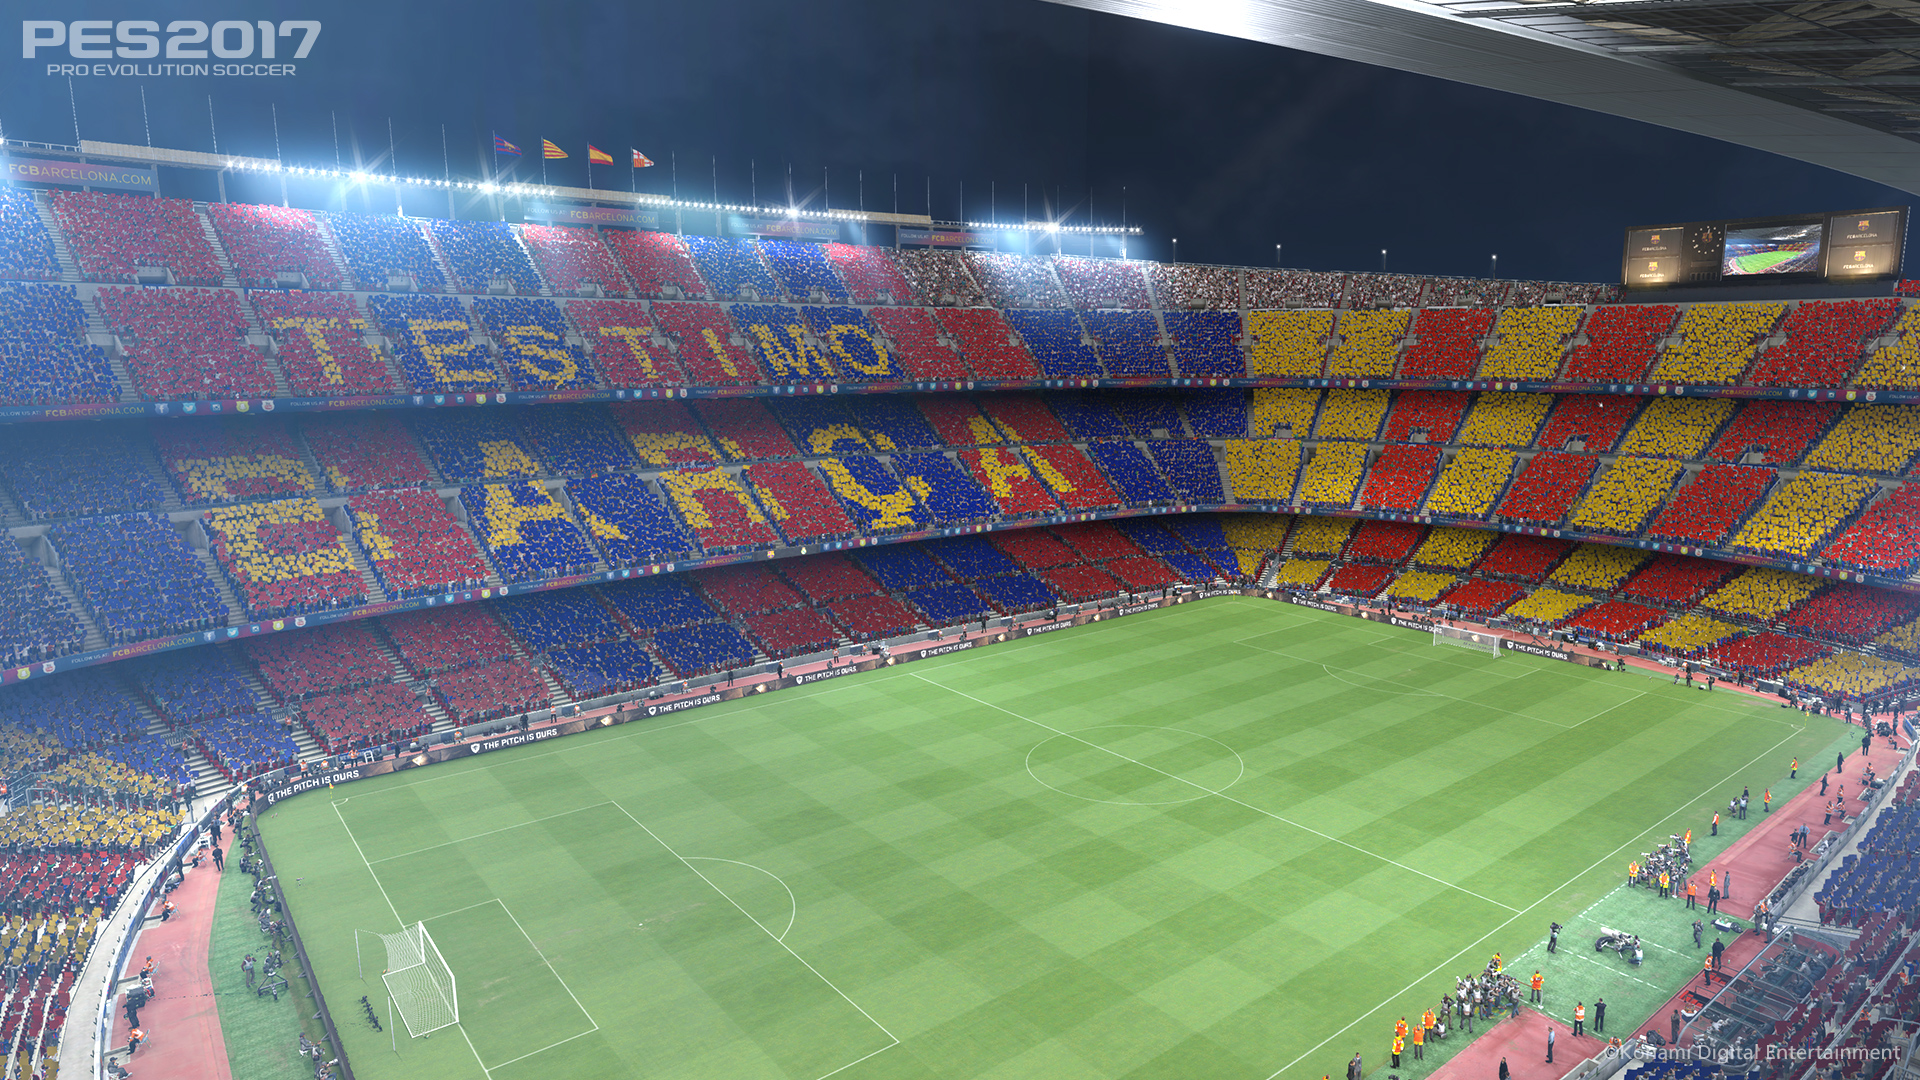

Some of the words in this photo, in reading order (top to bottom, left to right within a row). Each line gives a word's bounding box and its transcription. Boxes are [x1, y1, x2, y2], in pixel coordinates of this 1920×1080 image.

[8, 163, 152, 185] FCBARCELONA.COM
[570, 210, 655, 224] FCBARCELONA.COM
[766, 224, 836, 236] FCBARCELONA.COM
[931, 235, 994, 244] FCBARCELONA.COM
[329, 398, 406, 407] FCBARCELONA.COM
[548, 392, 610, 400] FCBARCELONA.COM
[45, 406, 145, 418] FCBARCELONA.COM
[352, 601, 420, 616] FCBARCELONA.COM
[71, 654, 93, 663] FOLLOW
[112, 637, 196, 658] FCBARCELONA.COM
[1514, 643, 1526, 652] THE
[1527, 646, 1544, 655] PITCH
[1551, 651, 1568, 660] OURS
[805, 674, 816, 682] THE
[817, 670, 834, 679] PITCH
[841, 665, 857, 674] OURS
[658, 705, 672, 713] THE
[673, 699, 693, 710] PITCH
[702, 694, 720, 703] OURS
[483, 740, 500, 749] THE
[501, 735, 525, 747] PITCH
[526, 733, 534, 741] IS
[535, 728, 557, 739] OURS
[275, 786, 292, 798] THE
[293, 778, 319, 792] PITCH
[321, 775, 331, 784] IS
[333, 769, 359, 782] OURS
